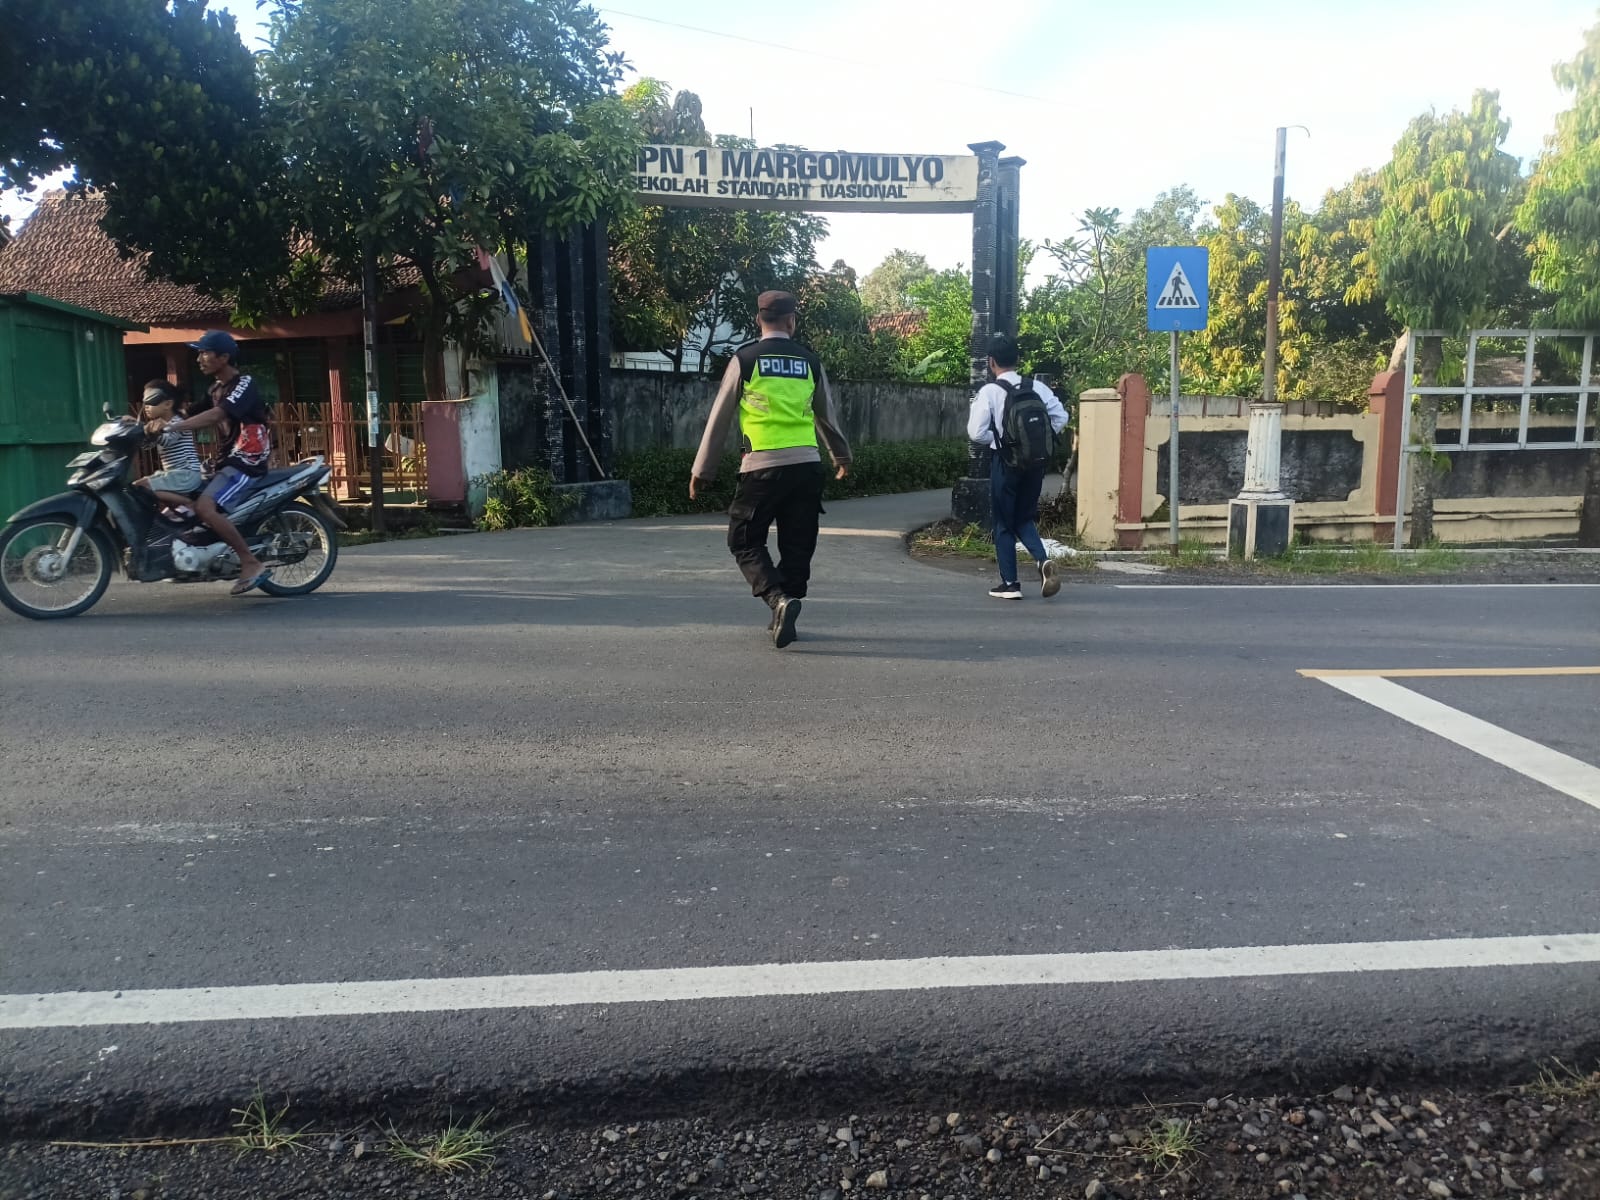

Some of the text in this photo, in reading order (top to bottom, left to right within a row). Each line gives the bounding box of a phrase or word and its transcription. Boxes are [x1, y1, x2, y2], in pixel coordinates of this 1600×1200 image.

[637, 146, 943, 182] PN 1 MARGOMULYO
[634, 176, 907, 199] EKOLAH STANDART NASIONAL
[760, 358, 807, 376] POLISI
